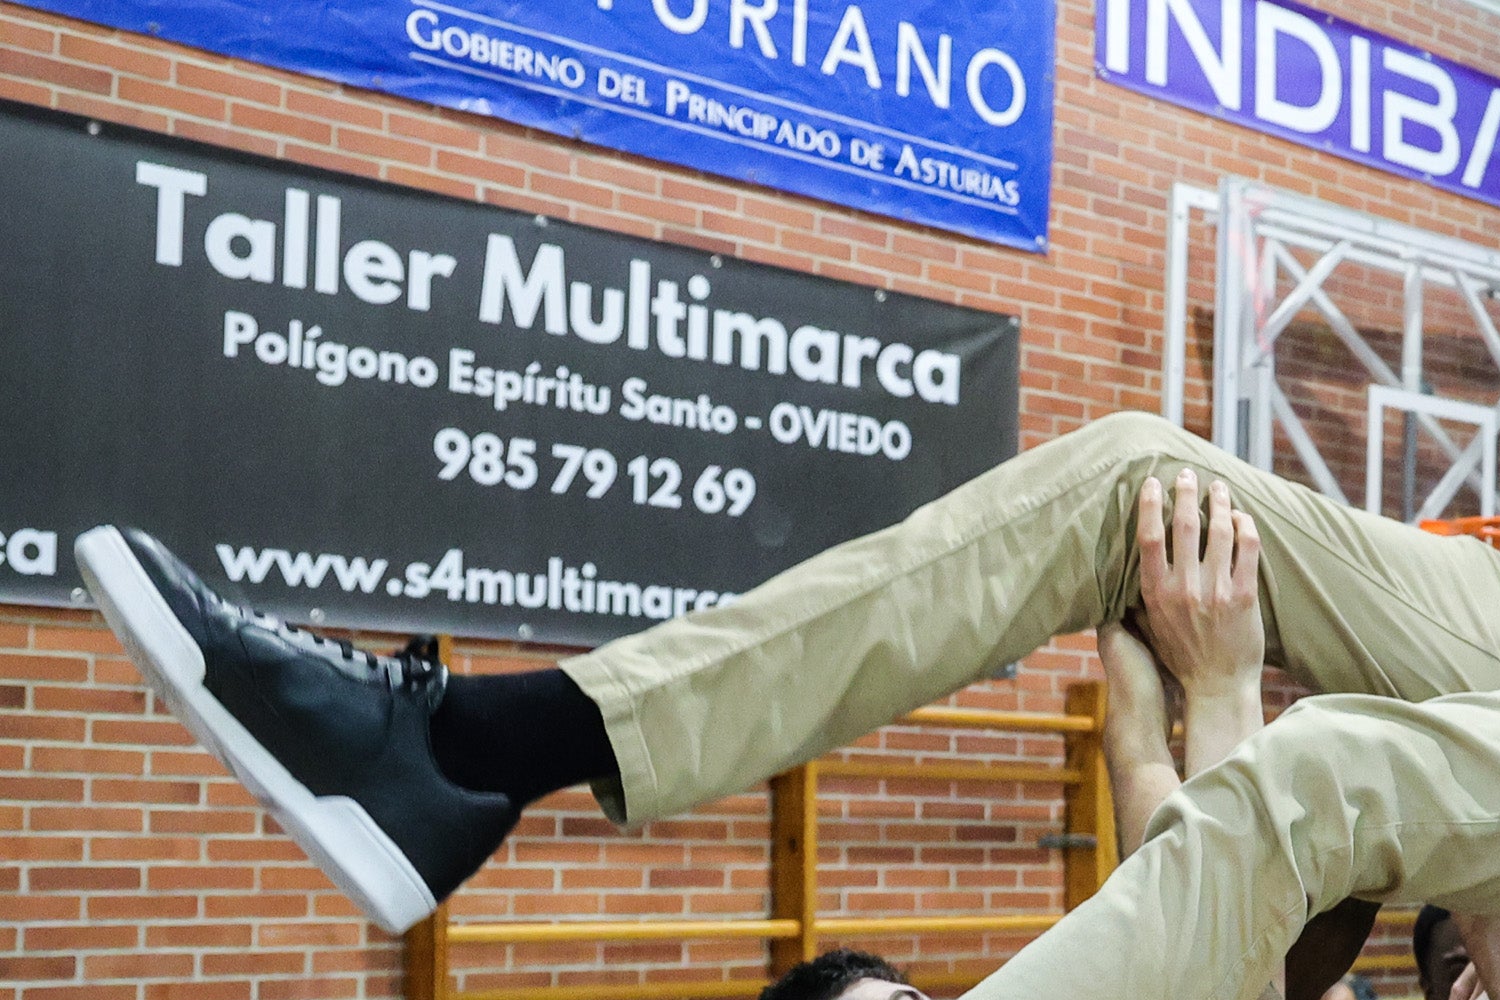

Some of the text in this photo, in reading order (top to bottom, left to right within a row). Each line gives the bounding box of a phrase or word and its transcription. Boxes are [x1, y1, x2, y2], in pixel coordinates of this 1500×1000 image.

[135, 163, 961, 405] Taller Multimarca
[224, 312, 438, 388] Polígono
[448, 347, 611, 418] Espíritu
[620, 380, 736, 435] Santo
[770, 410, 913, 462] OVIEDO
[433, 427, 757, 518] 985 79 12 69
